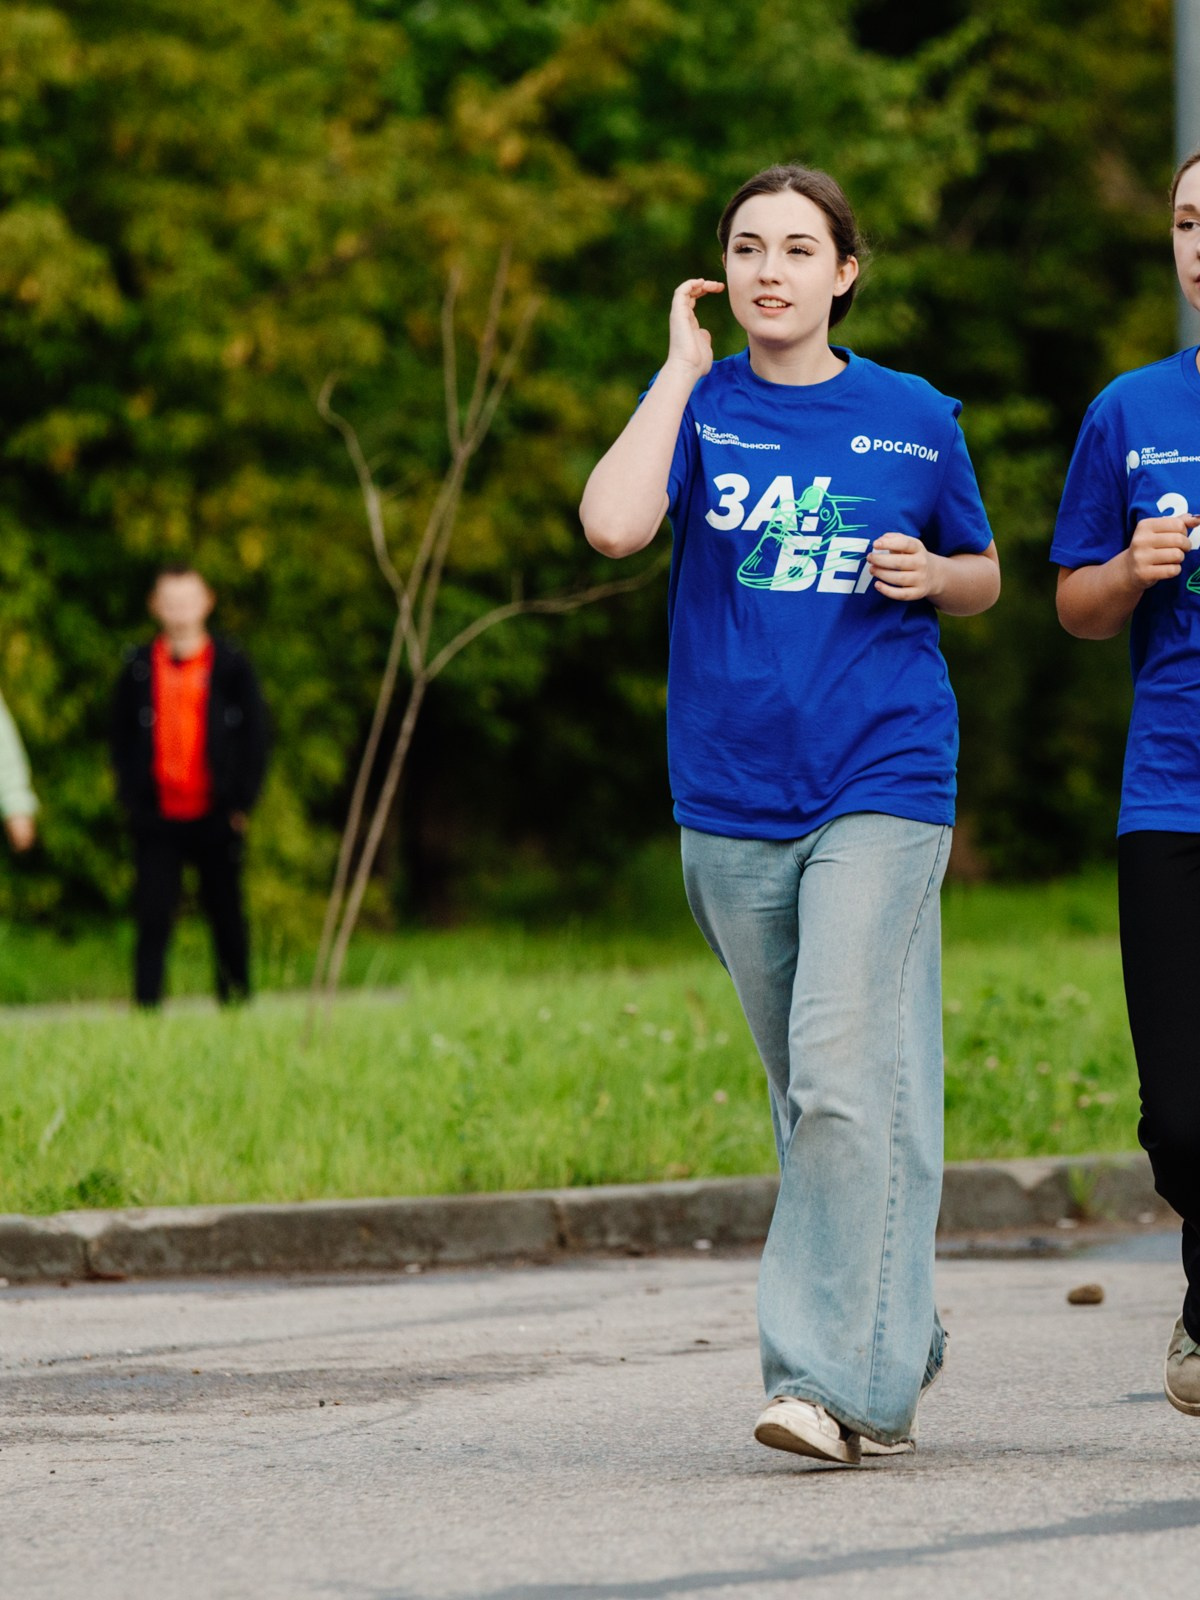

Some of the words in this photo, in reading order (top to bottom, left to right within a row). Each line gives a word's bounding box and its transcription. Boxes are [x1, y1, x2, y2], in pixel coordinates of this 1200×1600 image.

[873, 439, 939, 463] РОСАТОМ
[1141, 446, 1156, 454] ЛЕТ
[1141, 449, 1179, 460] АТОМНОЙ
[705, 473, 832, 532] ЗА!
